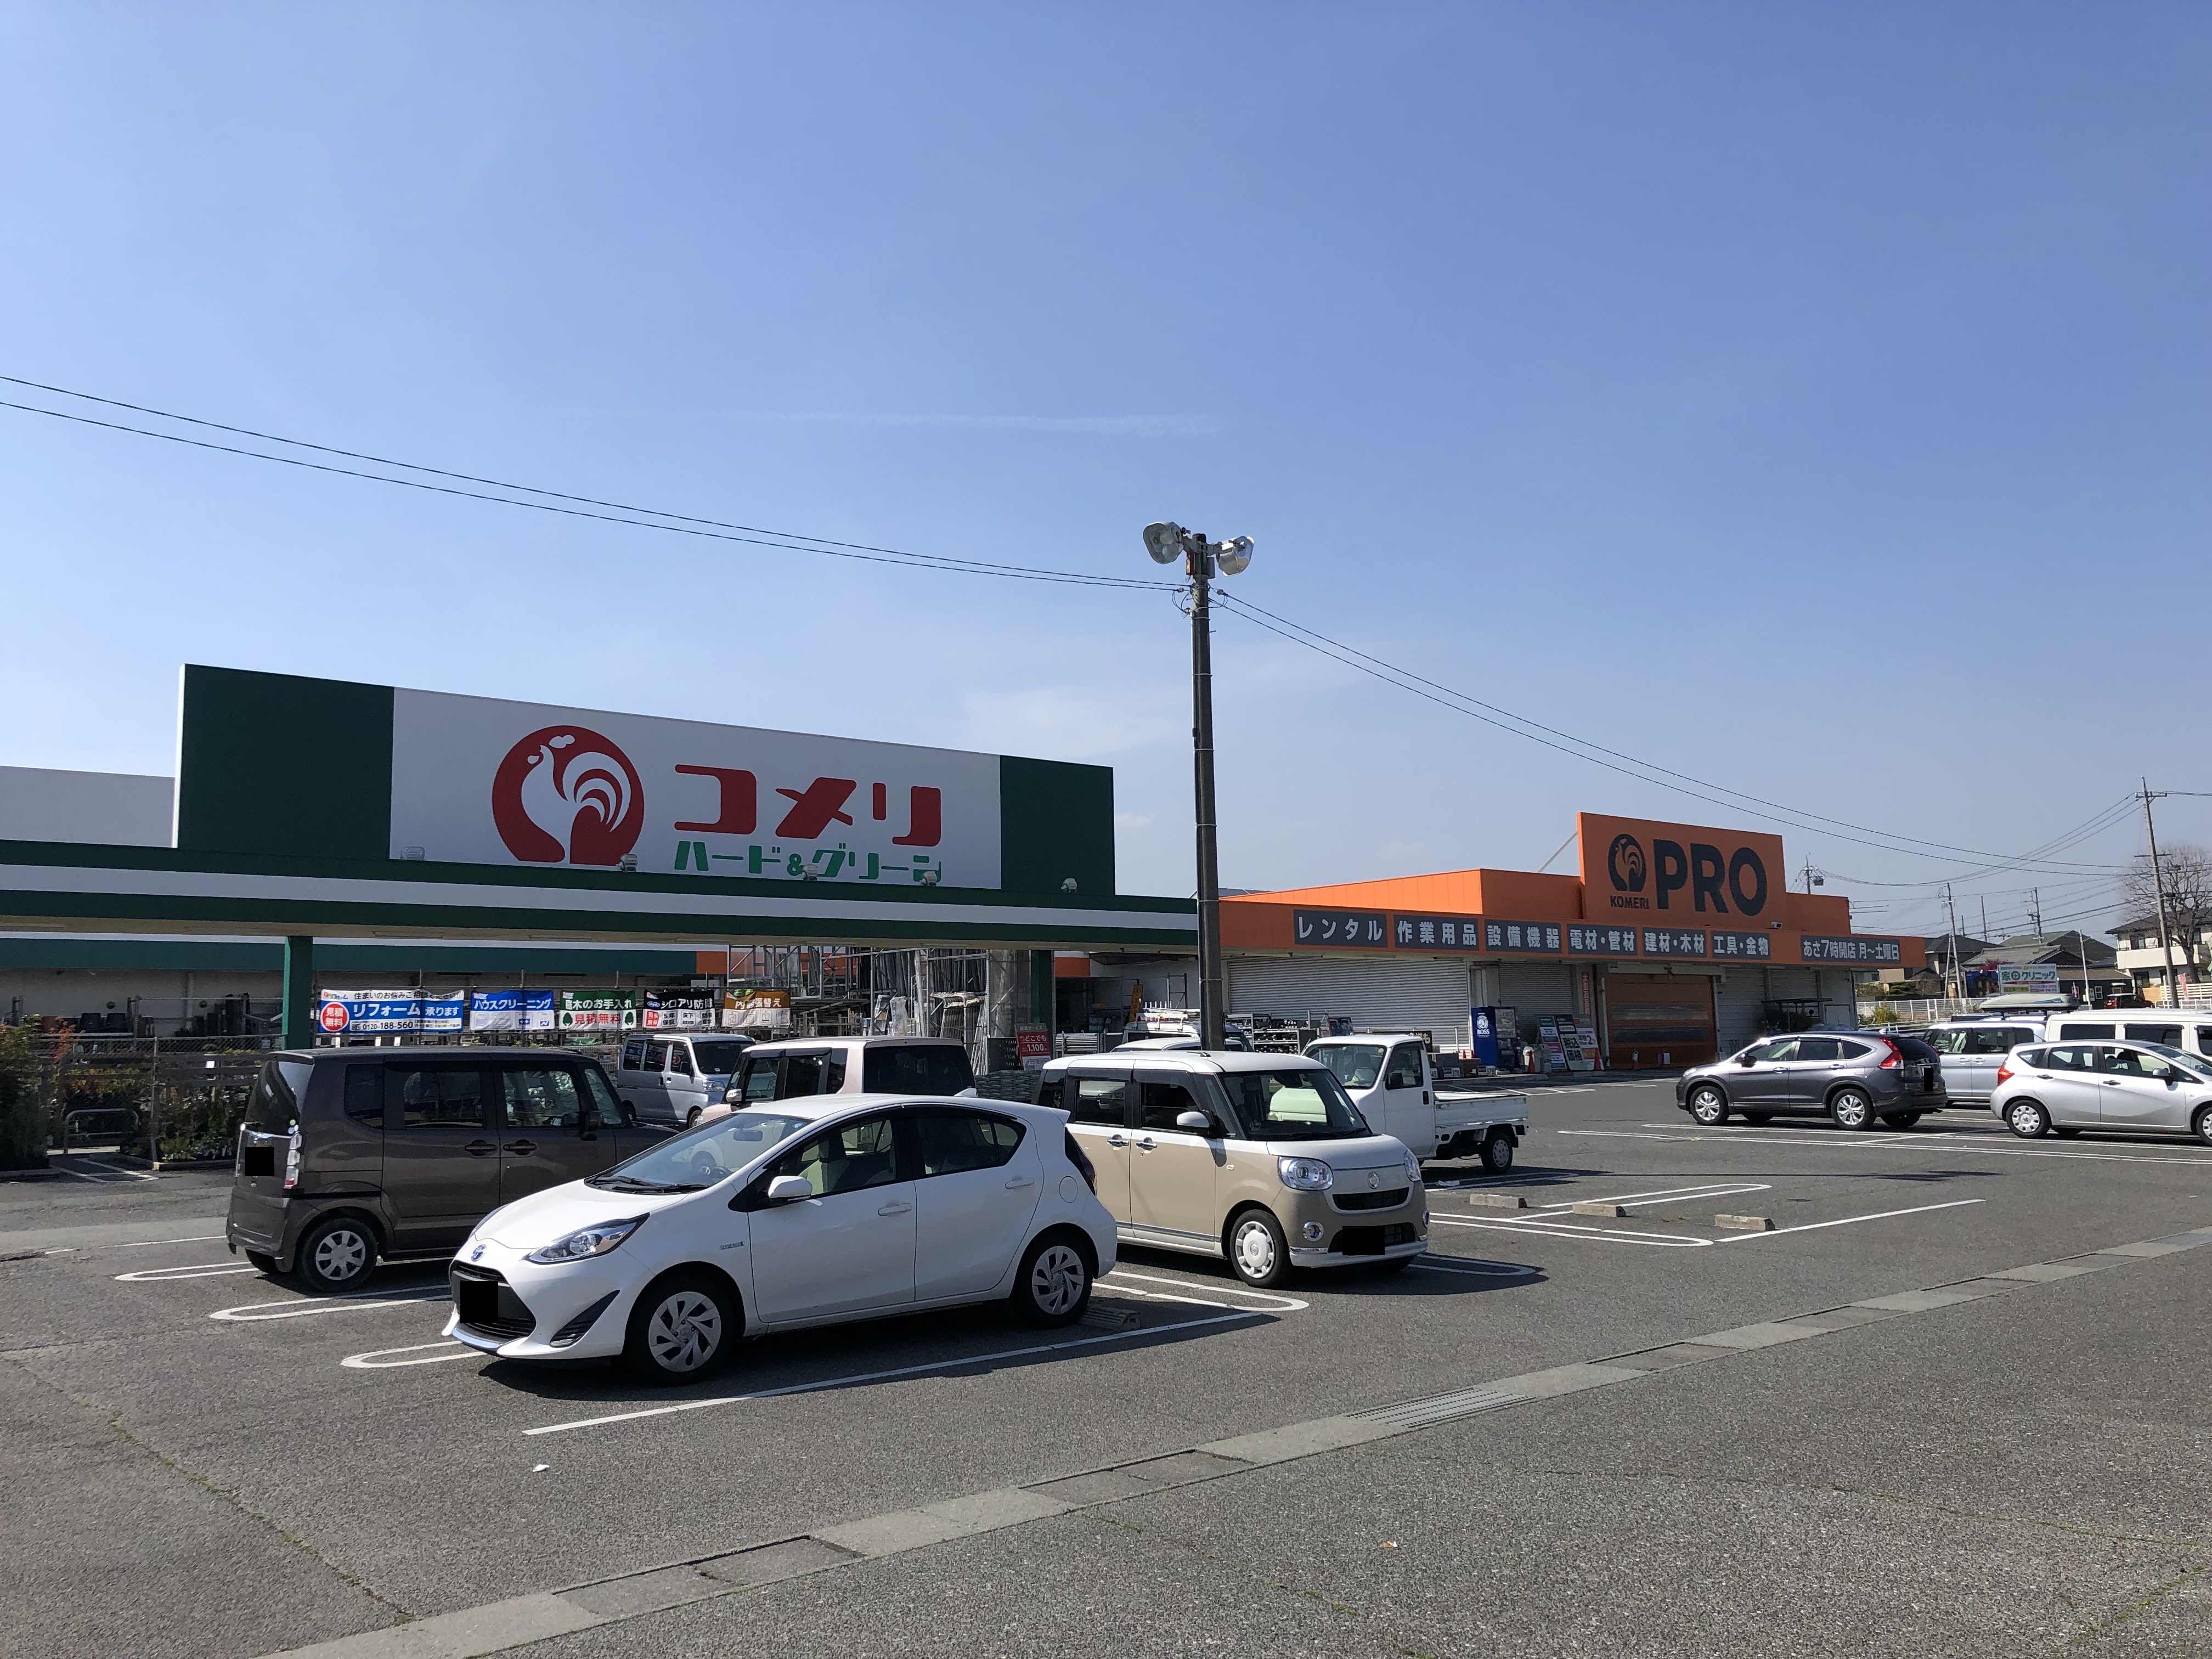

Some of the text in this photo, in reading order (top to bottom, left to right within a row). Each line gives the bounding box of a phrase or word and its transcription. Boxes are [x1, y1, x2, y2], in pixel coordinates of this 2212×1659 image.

[675, 764, 941, 847] コメリ
[1653, 838, 1768, 916] PRO
[1610, 895, 1649, 910] KOMERI
[1298, 917, 1383, 941] レンタル
[1397, 921, 1477, 946] 作業用品
[1487, 925, 1559, 949] 設備機器
[1570, 929, 1635, 951] 電材・管材
[1645, 932, 1705, 953] 建材・木材
[1714, 935, 1769, 956] 工具・金物
[1803, 939, 1856, 959] あさ7時開店
[353, 1003, 459, 1017] リフォーム 承ります
[474, 998, 552, 1010] ハウスクリーニング
[565, 998, 632, 1010] 庭木のお手入れ
[661, 998, 713, 1009] シロアリ防除
[325, 1007, 343, 1017] 見積
[574, 1013, 622, 1025] 見積無料
[325, 1018, 343, 1027] 無料
[362, 1021, 414, 1030] 0120-188-560
[1027, 1043, 1044, 1052] 1,100
